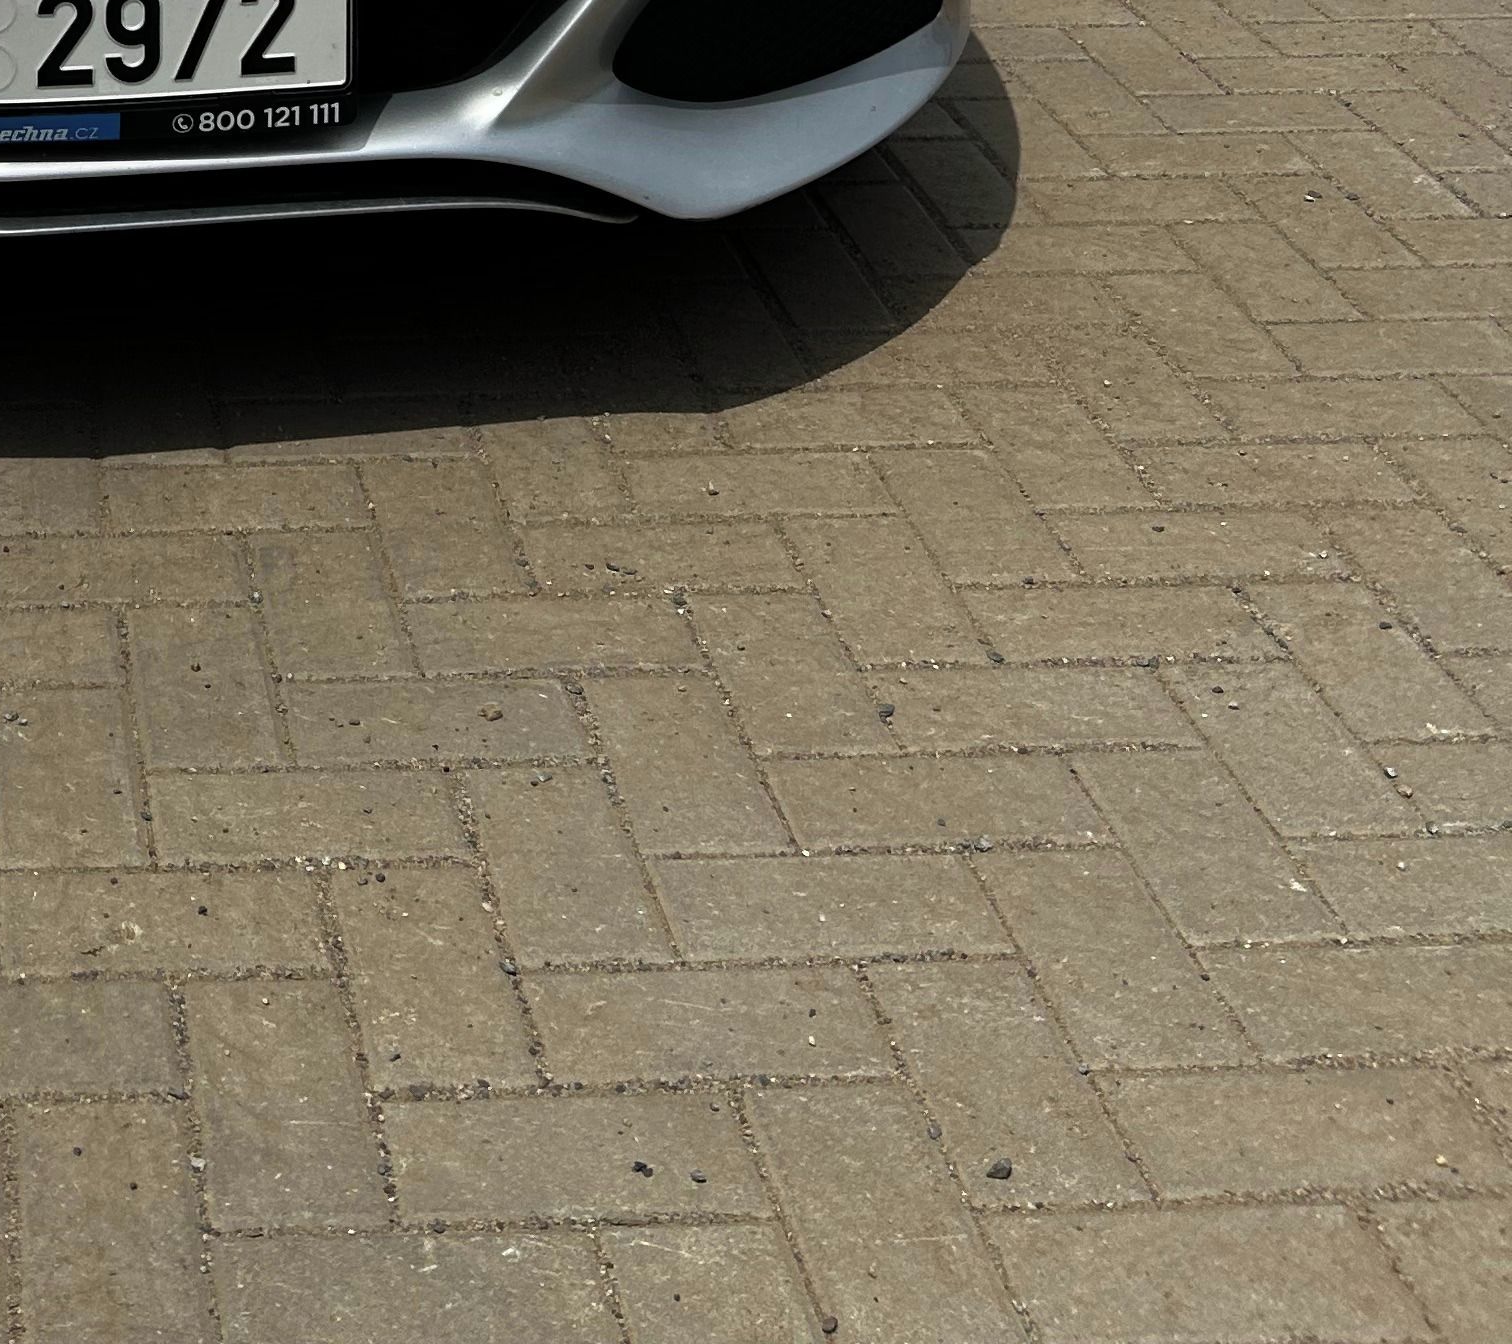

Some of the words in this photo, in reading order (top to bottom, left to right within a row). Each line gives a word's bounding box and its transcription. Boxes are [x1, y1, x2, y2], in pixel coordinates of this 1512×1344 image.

[198, 109, 256, 132] 800
[263, 105, 301, 128] 121
[309, 102, 340, 125] 111
